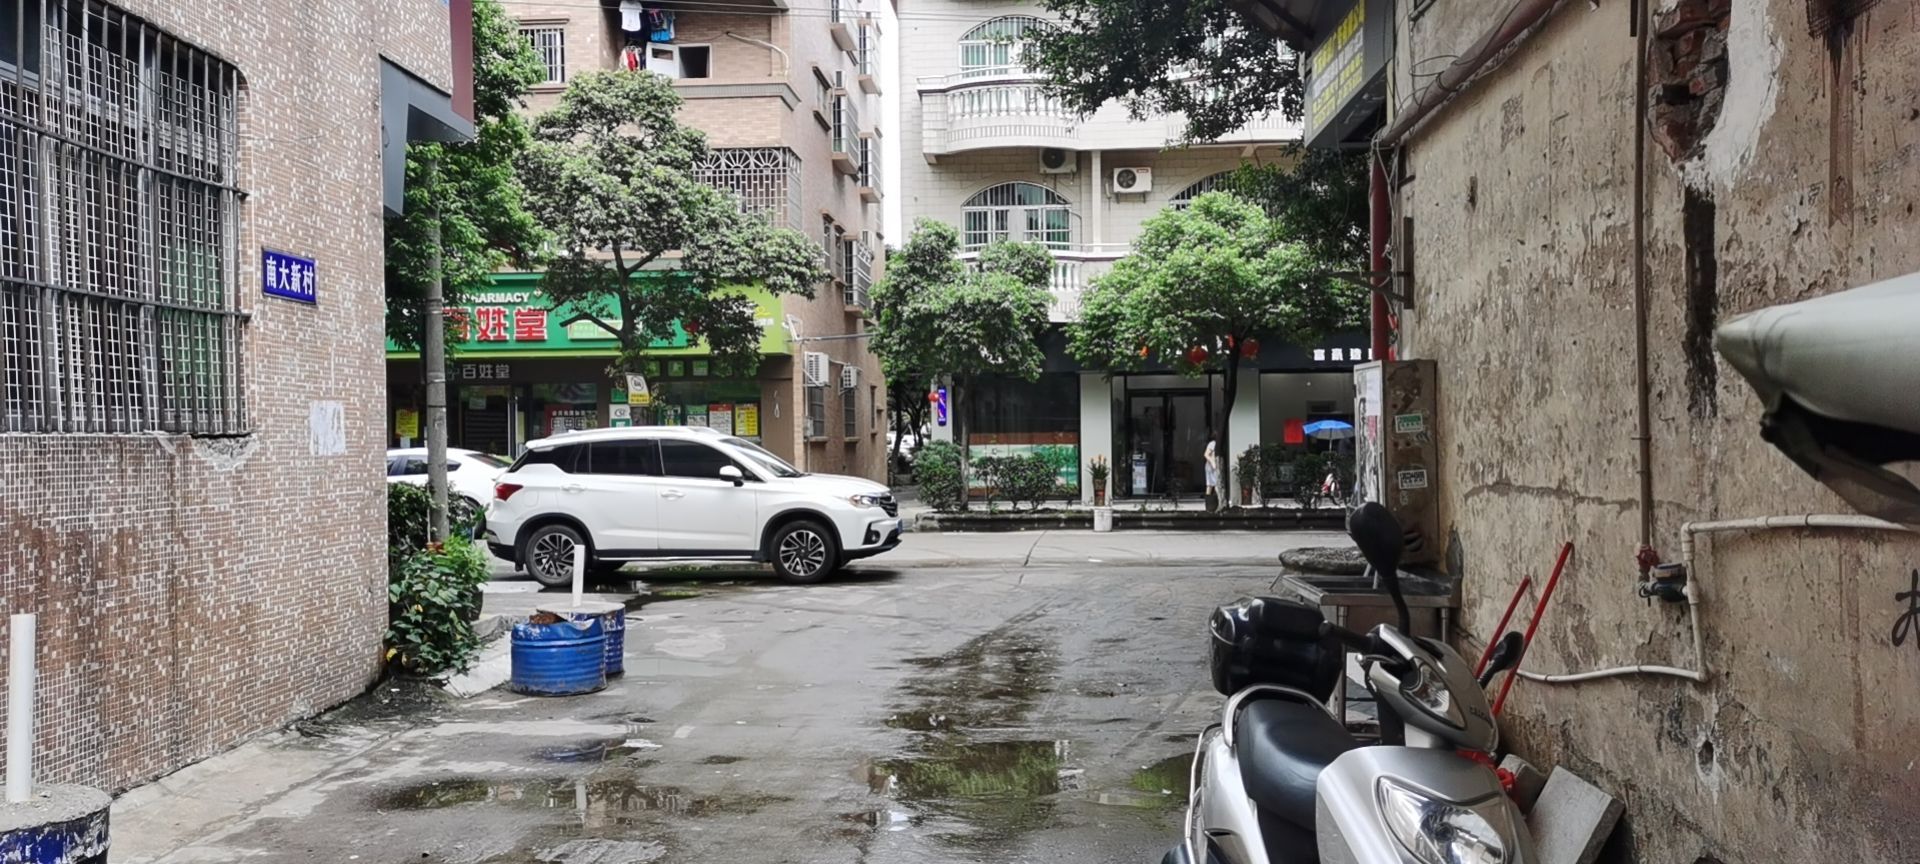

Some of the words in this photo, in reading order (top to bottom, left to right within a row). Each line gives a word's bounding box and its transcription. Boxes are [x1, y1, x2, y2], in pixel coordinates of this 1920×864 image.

[265, 255, 314, 296] 南大新村
[461, 363, 511, 379] 百姓堂
